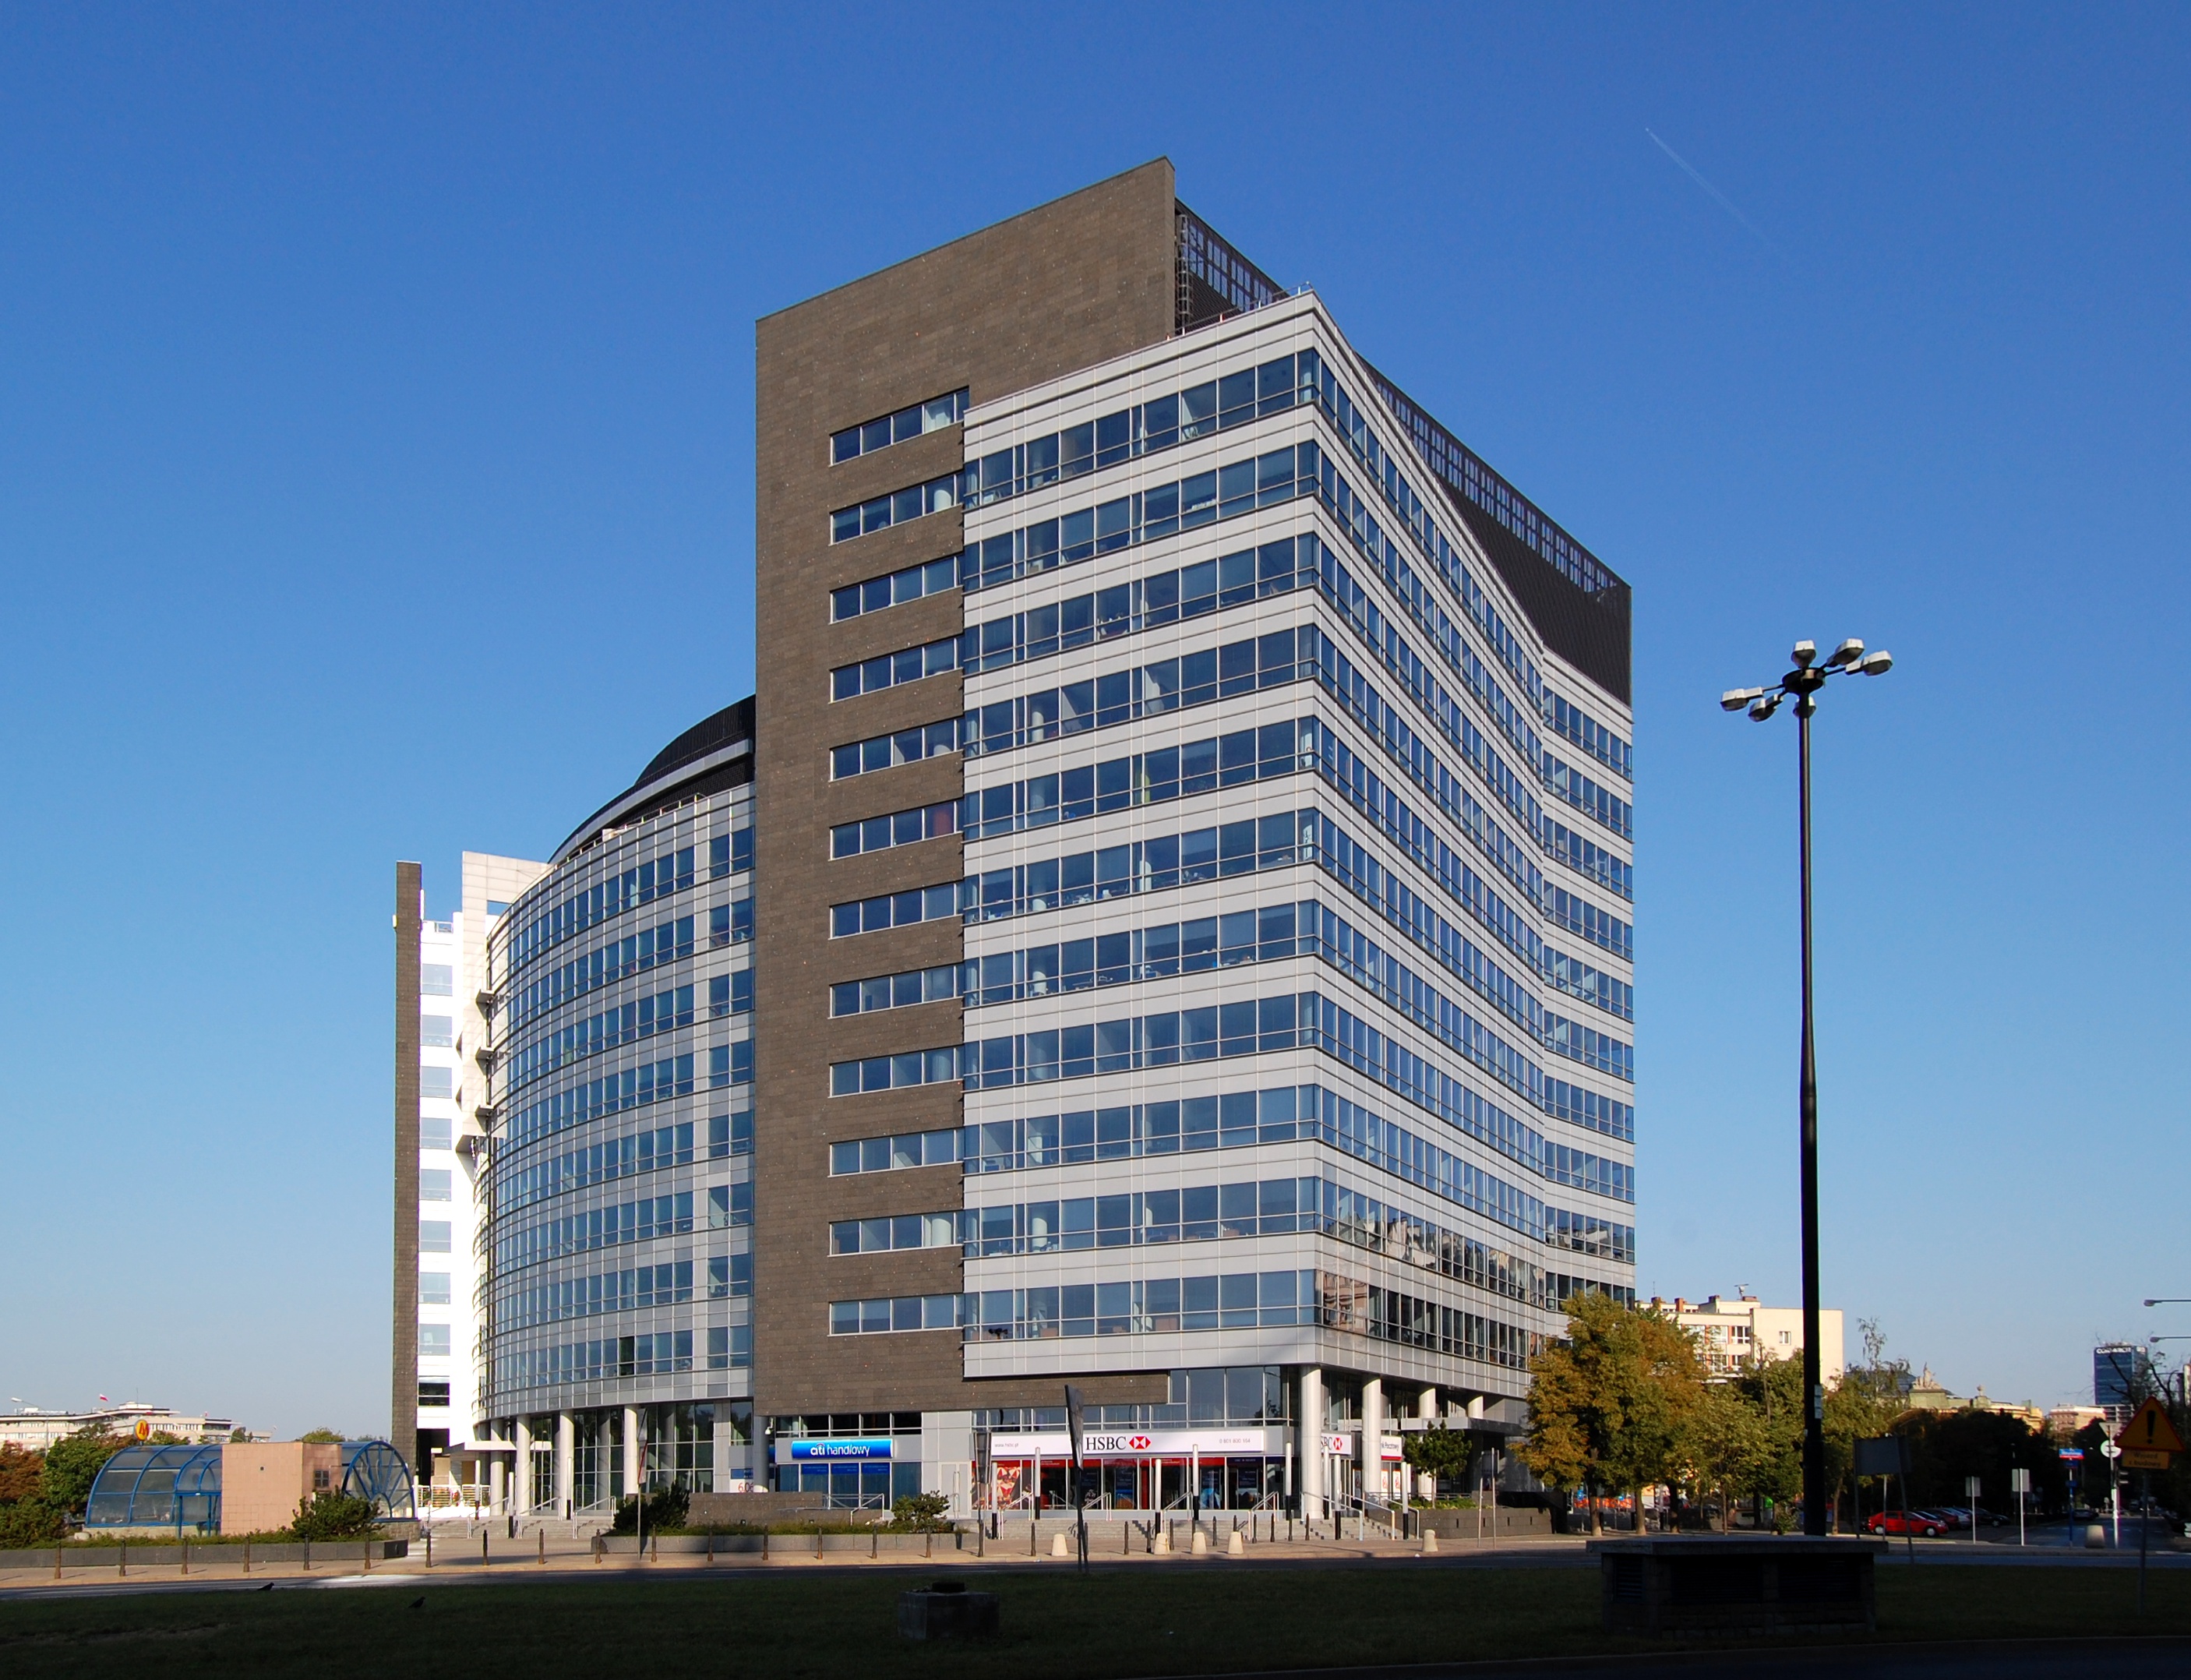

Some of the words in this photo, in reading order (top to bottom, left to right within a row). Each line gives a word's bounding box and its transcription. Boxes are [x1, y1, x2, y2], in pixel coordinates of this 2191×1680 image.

[810, 1443, 825, 1456] citi
[827, 1444, 870, 1457] handlowy
[1085, 1436, 1127, 1450] HSBC
